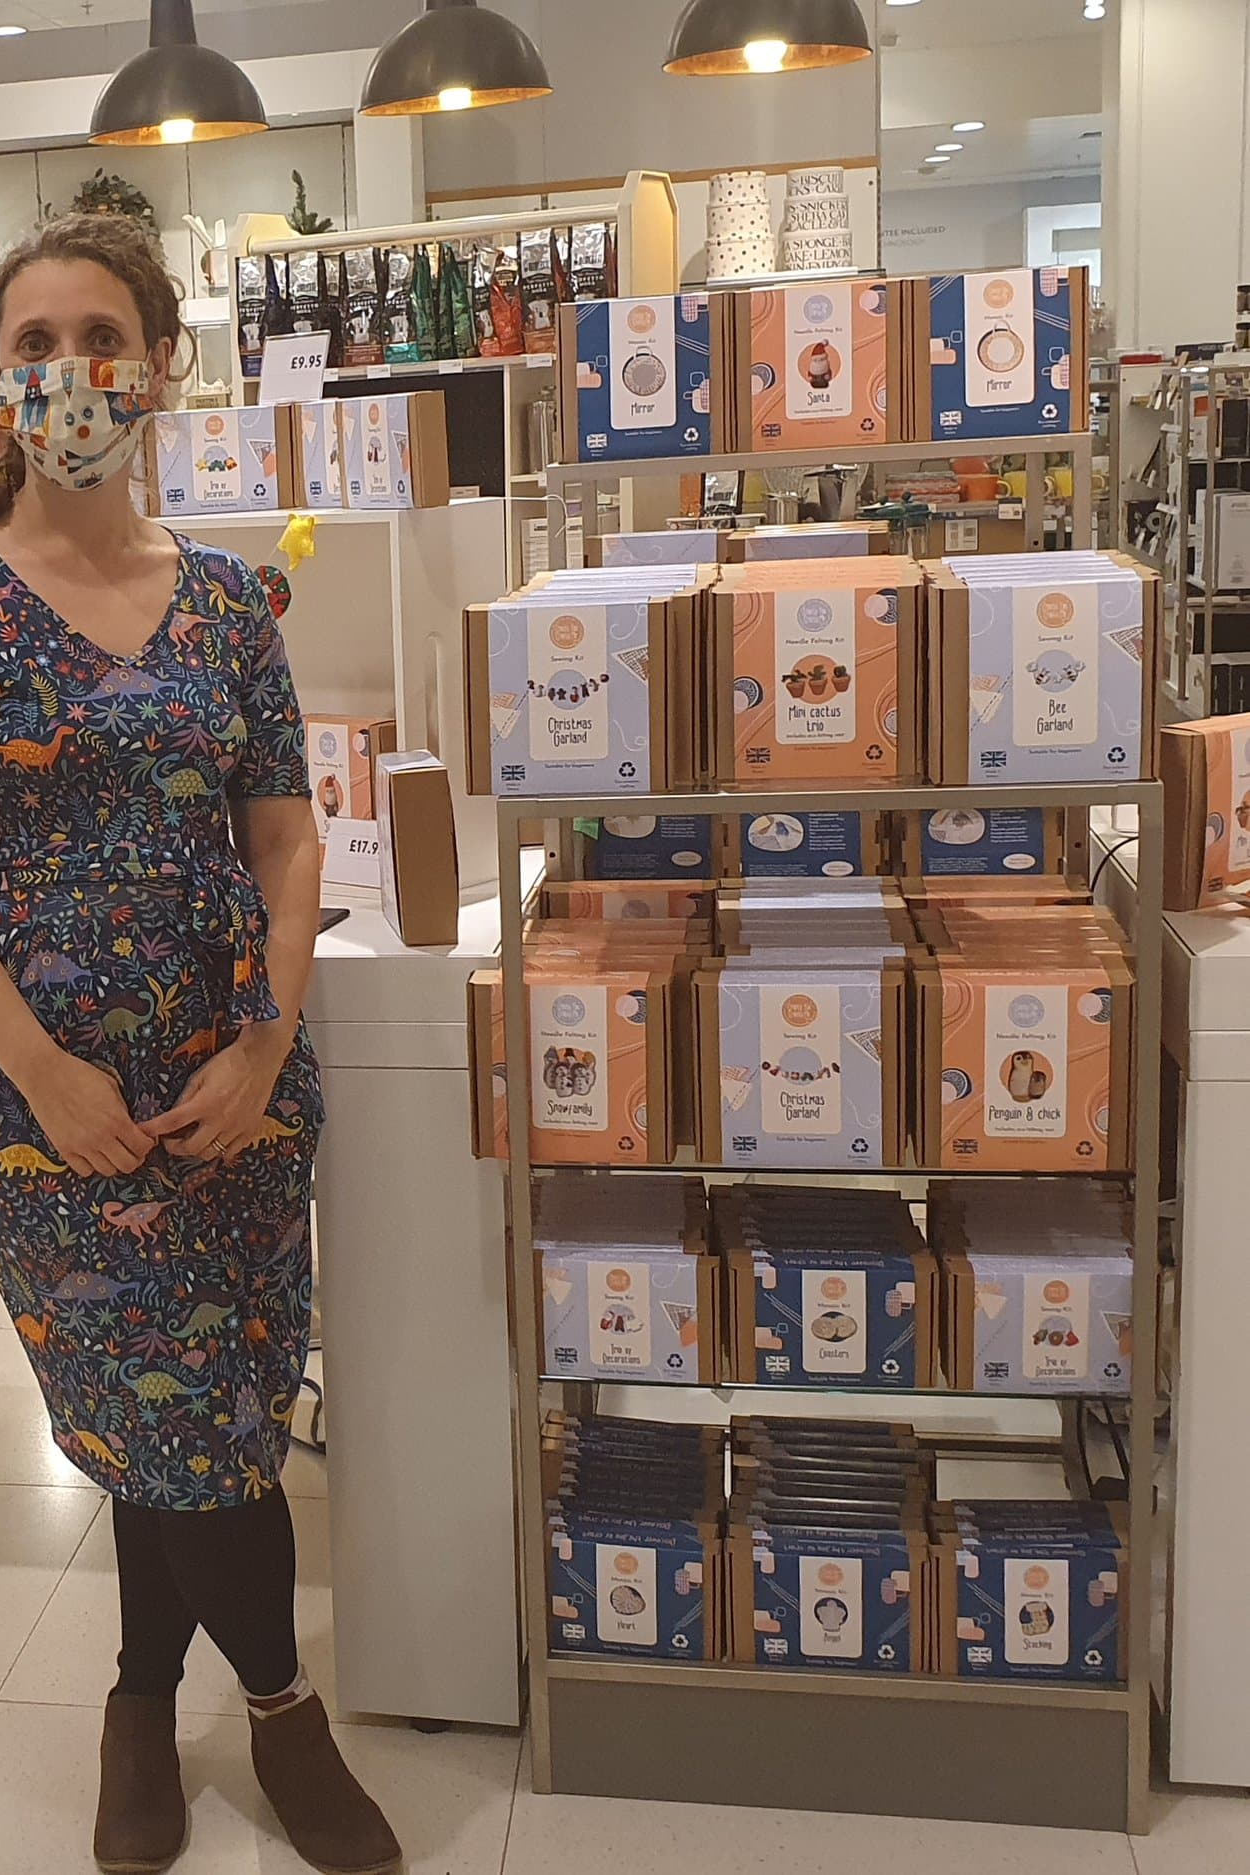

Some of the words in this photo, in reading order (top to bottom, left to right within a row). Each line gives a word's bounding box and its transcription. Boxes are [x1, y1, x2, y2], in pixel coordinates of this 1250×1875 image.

[792, 237, 837, 249] SPONGE
[290, 355, 322, 370] £9.95
[807, 391, 830, 406] Santa
[788, 705, 806, 720] Mini
[810, 705, 841, 718] cactus
[1048, 699, 1067, 715] Bee
[547, 716, 593, 734] Christmas
[806, 719, 825, 732] trio
[1036, 717, 1074, 735] Garland
[553, 731, 588, 748] Garland
[349, 839, 379, 855] £17.9
[780, 1091, 825, 1107] Christmas
[785, 1105, 820, 1121] Garland
[988, 1104, 1022, 1121] Penguin
[1037, 1106, 1061, 1120] chick
